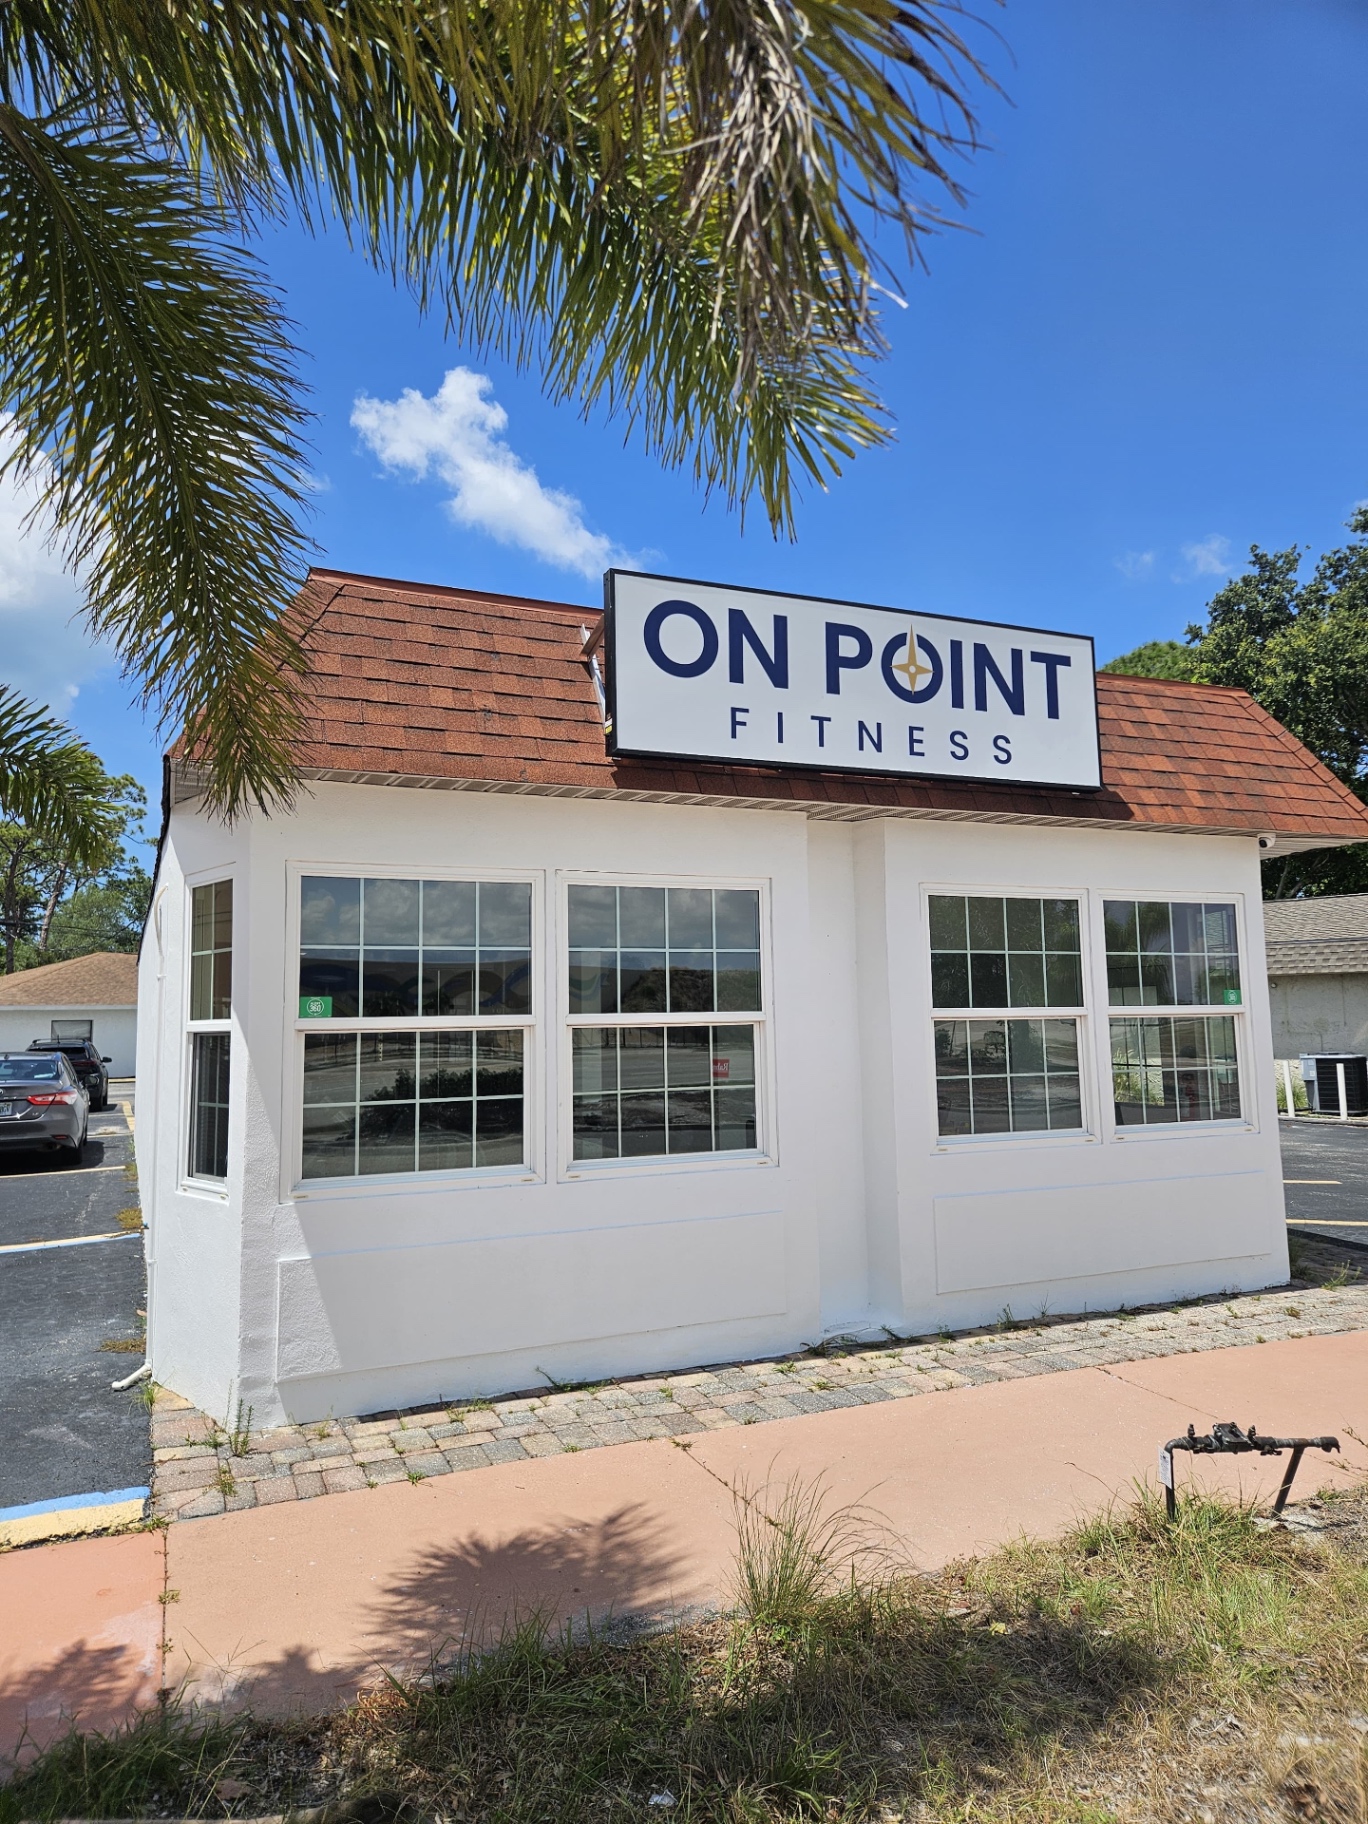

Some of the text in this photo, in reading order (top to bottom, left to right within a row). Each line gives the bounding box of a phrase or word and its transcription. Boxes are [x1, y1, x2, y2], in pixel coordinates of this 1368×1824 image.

[643, 599, 1072, 720] ON POINT
[730, 706, 1013, 765] FITNESS
